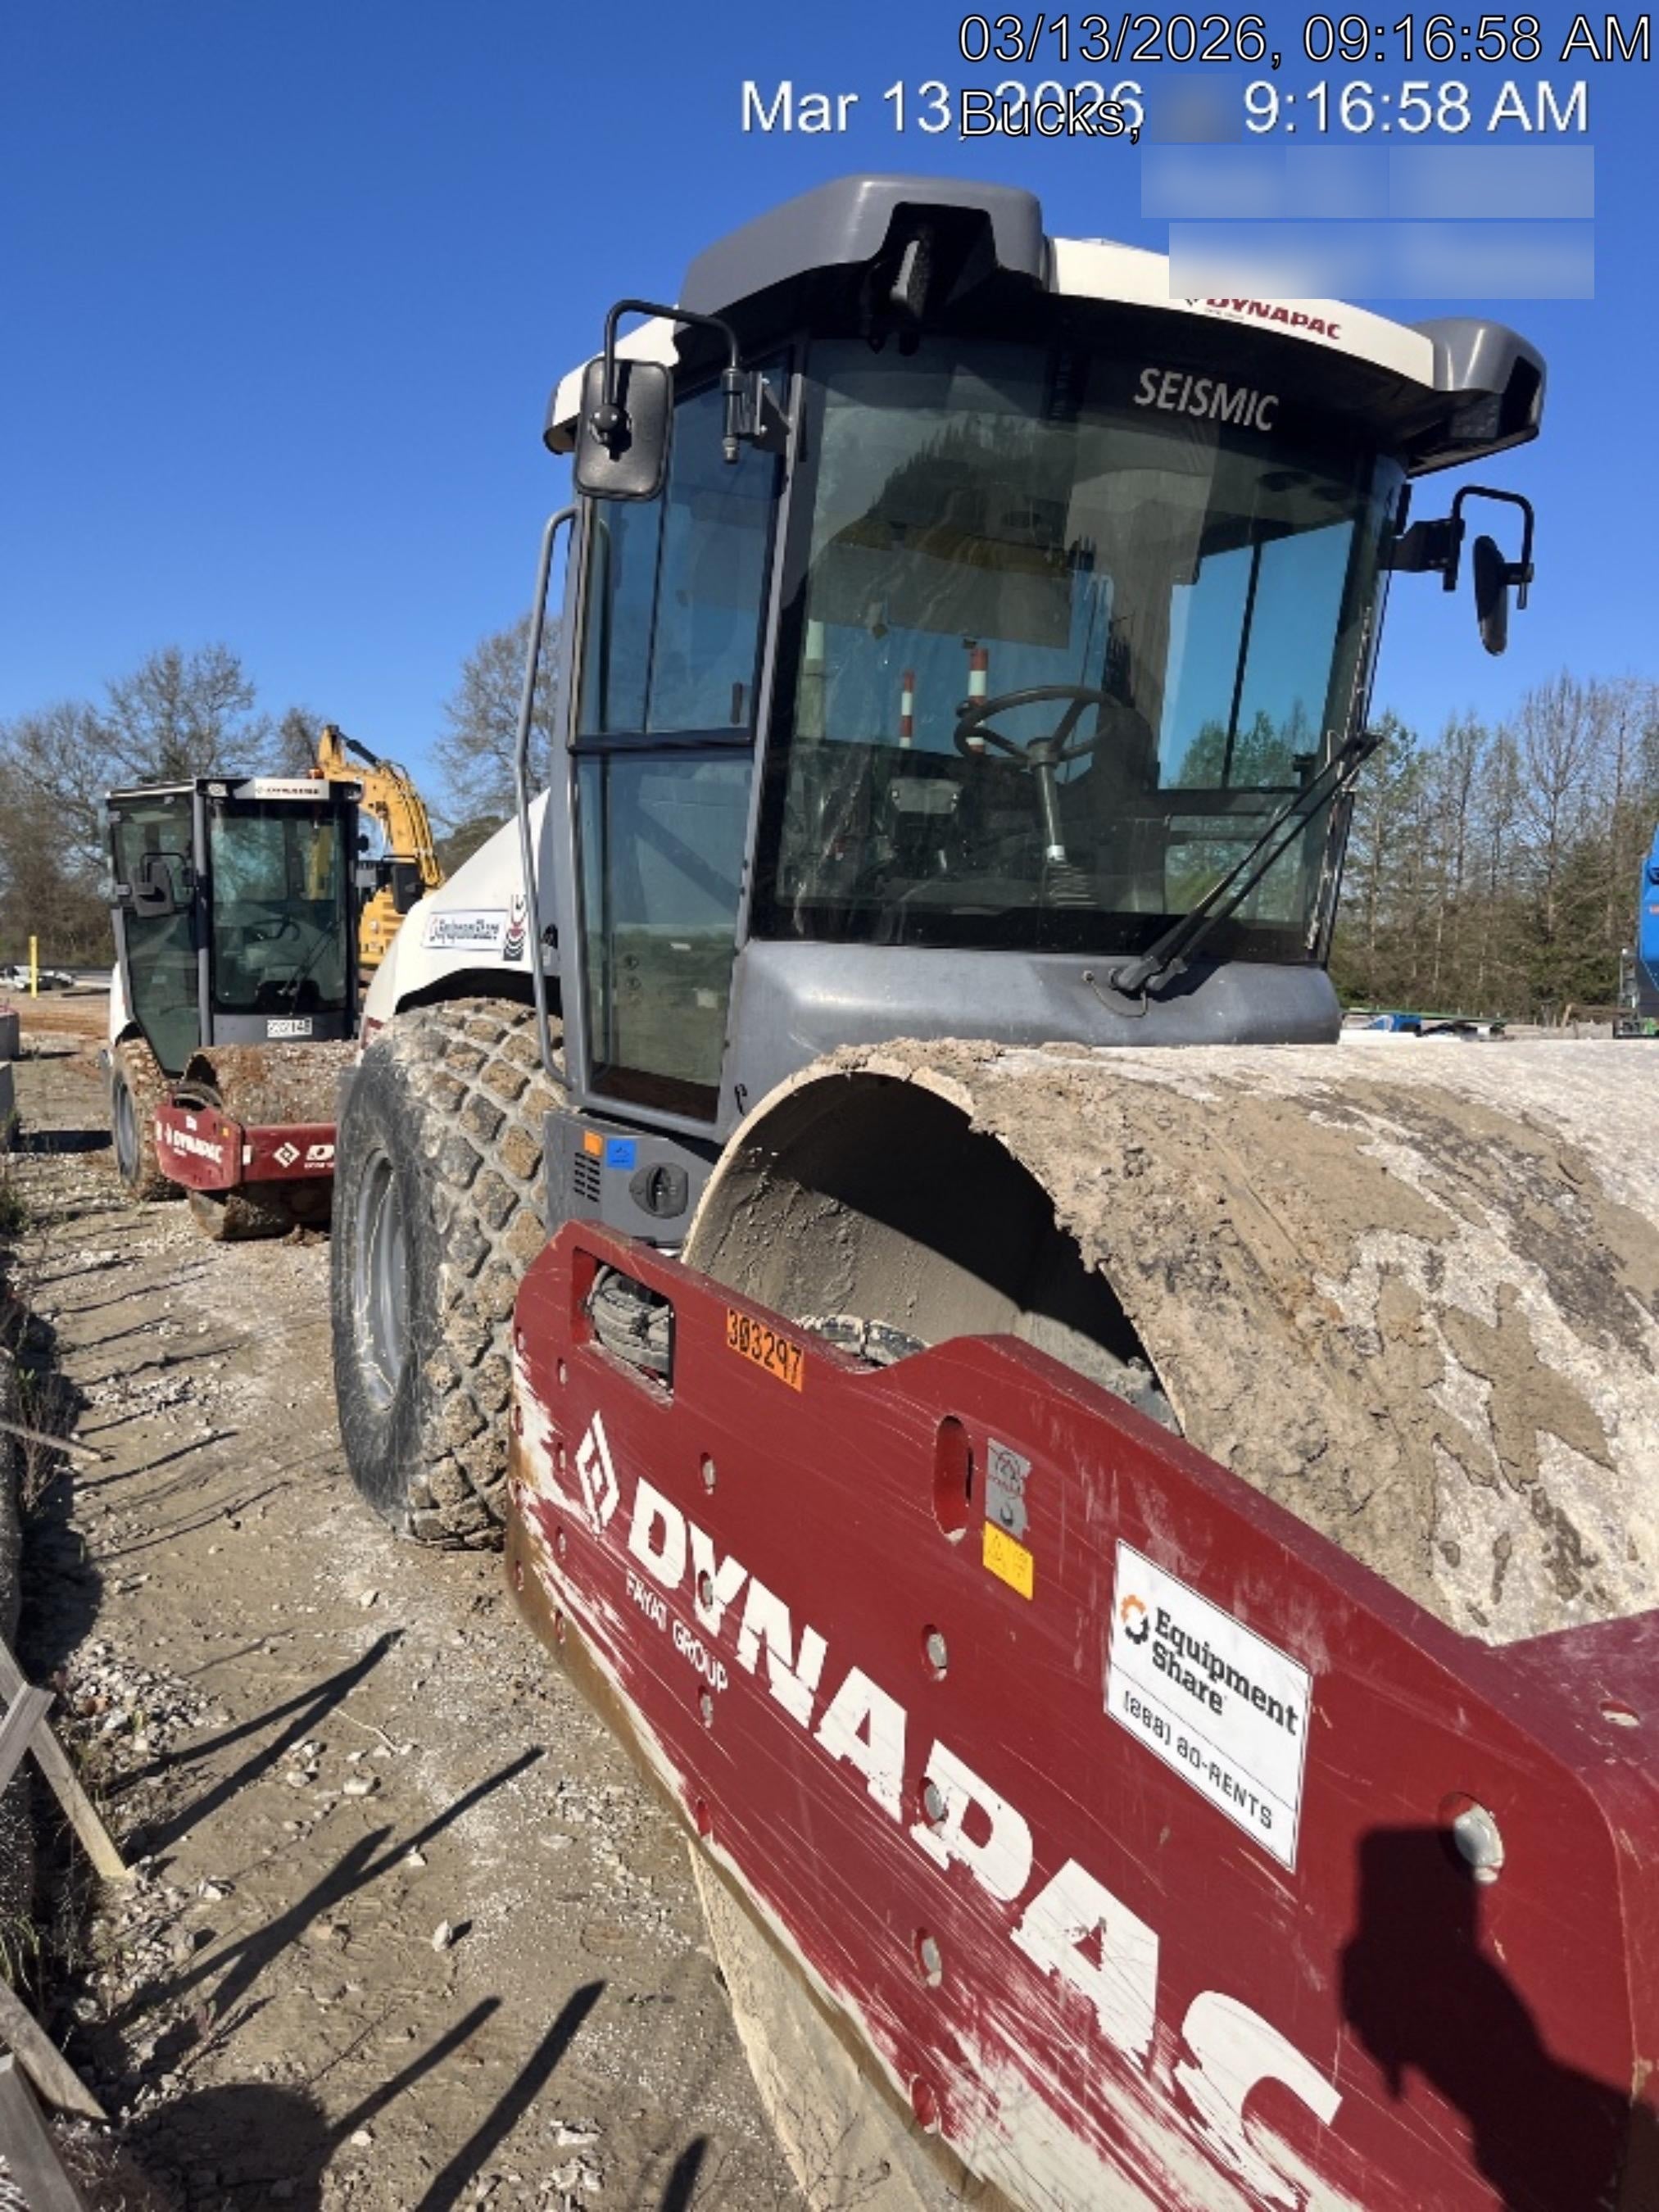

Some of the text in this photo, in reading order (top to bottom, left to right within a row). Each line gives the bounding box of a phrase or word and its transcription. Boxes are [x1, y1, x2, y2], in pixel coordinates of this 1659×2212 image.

[1133, 368, 1280, 431] SEISMIC
[729, 1309, 802, 1385] 303297
[625, 1569, 729, 1694] FAYAT GROUP
[1154, 1607, 1299, 1736] Equipment
[1152, 1643, 1225, 1716] Share
[1176, 1736, 1273, 1830] 80-RENTS
[628, 1476, 1344, 2210] DYNAPAC
